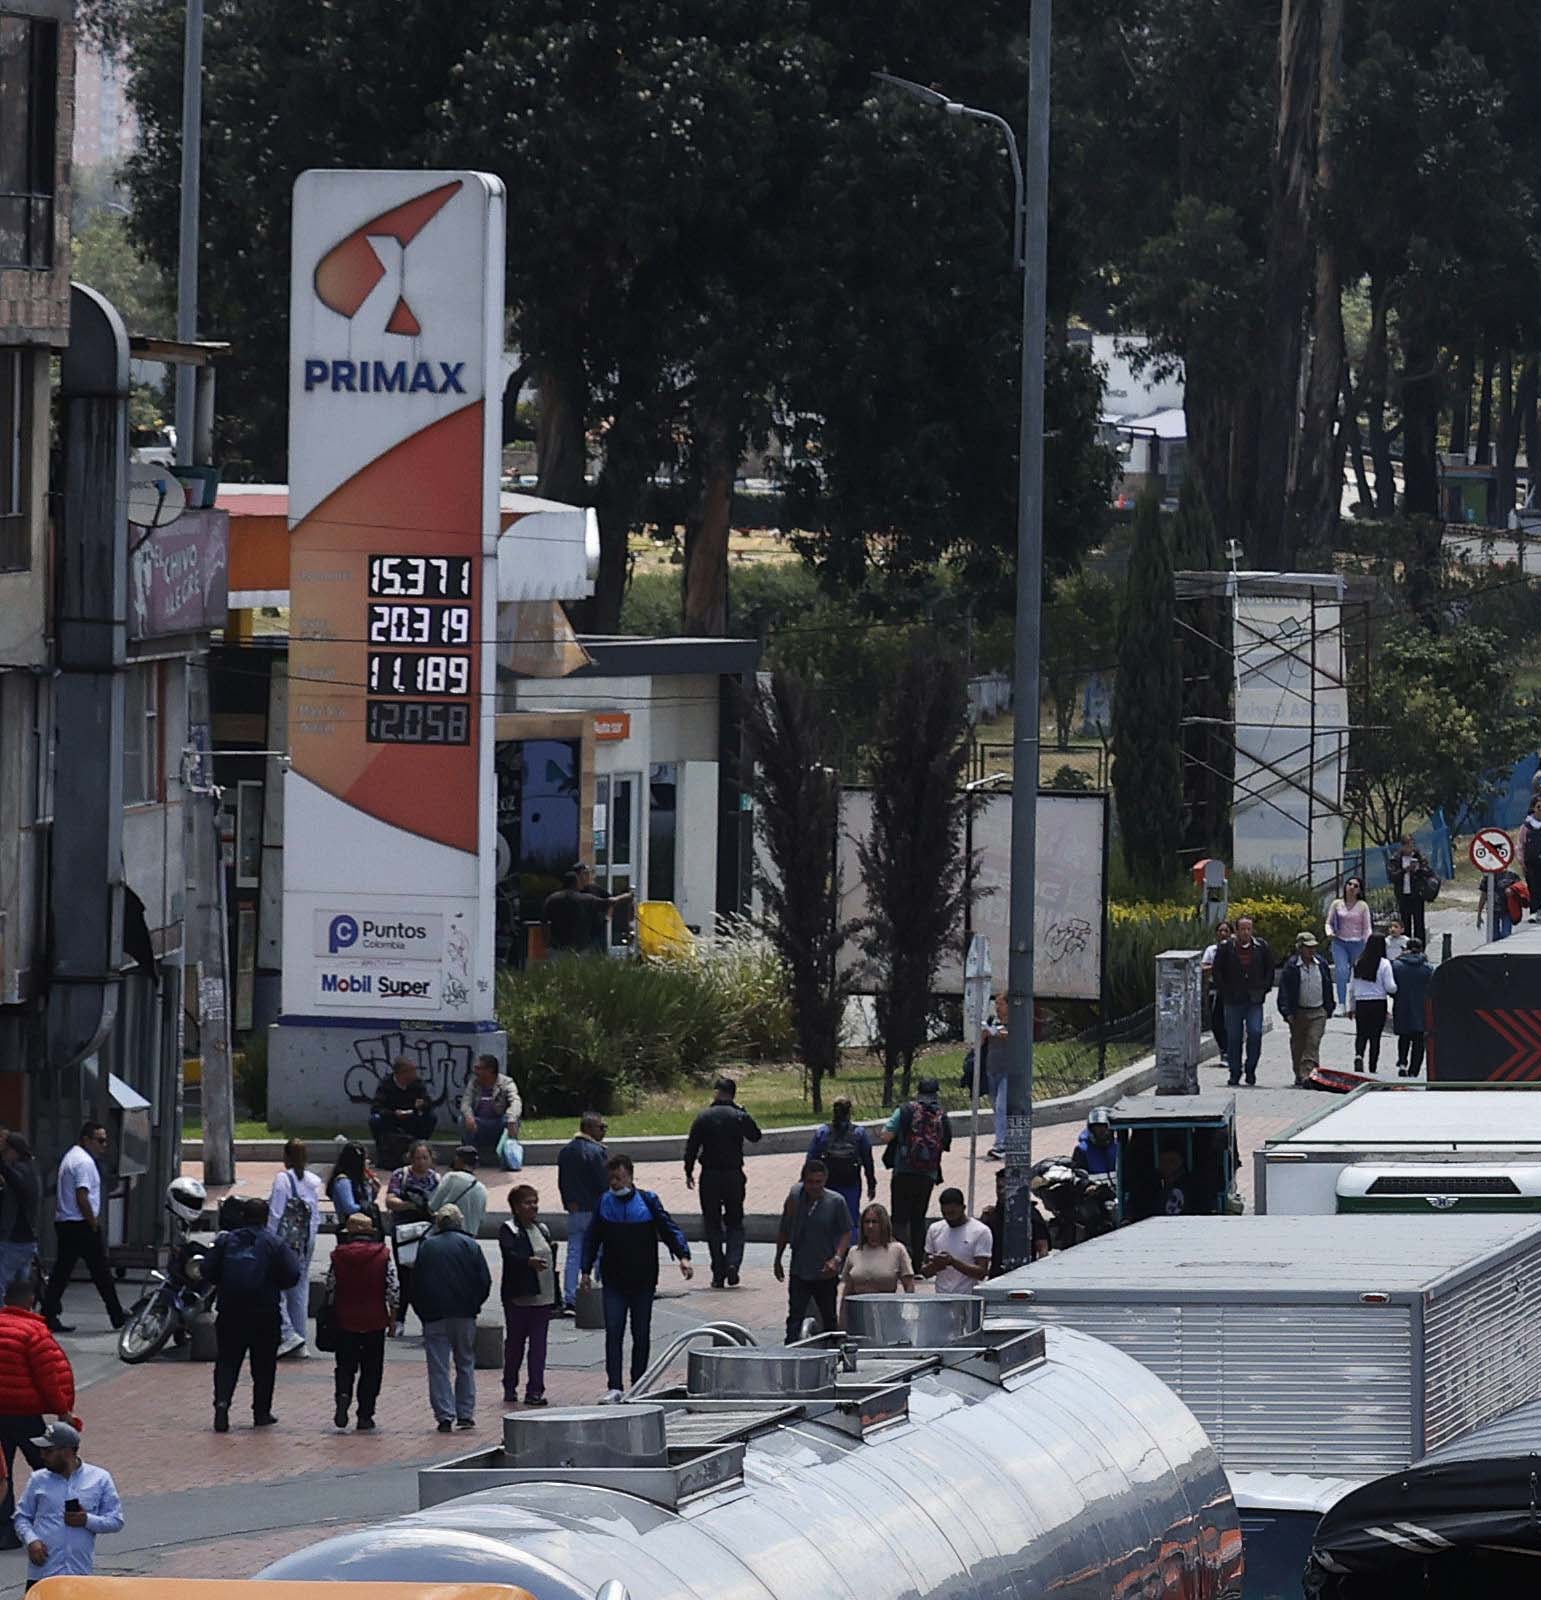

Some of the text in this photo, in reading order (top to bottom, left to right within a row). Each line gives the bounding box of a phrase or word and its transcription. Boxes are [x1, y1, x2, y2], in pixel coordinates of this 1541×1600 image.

[304, 360, 467, 394] PRIMAX
[362, 920, 427, 939] Puntos
[362, 939, 406, 950] Colombia
[321, 973, 372, 993] Mobil
[378, 976, 431, 996] Super
